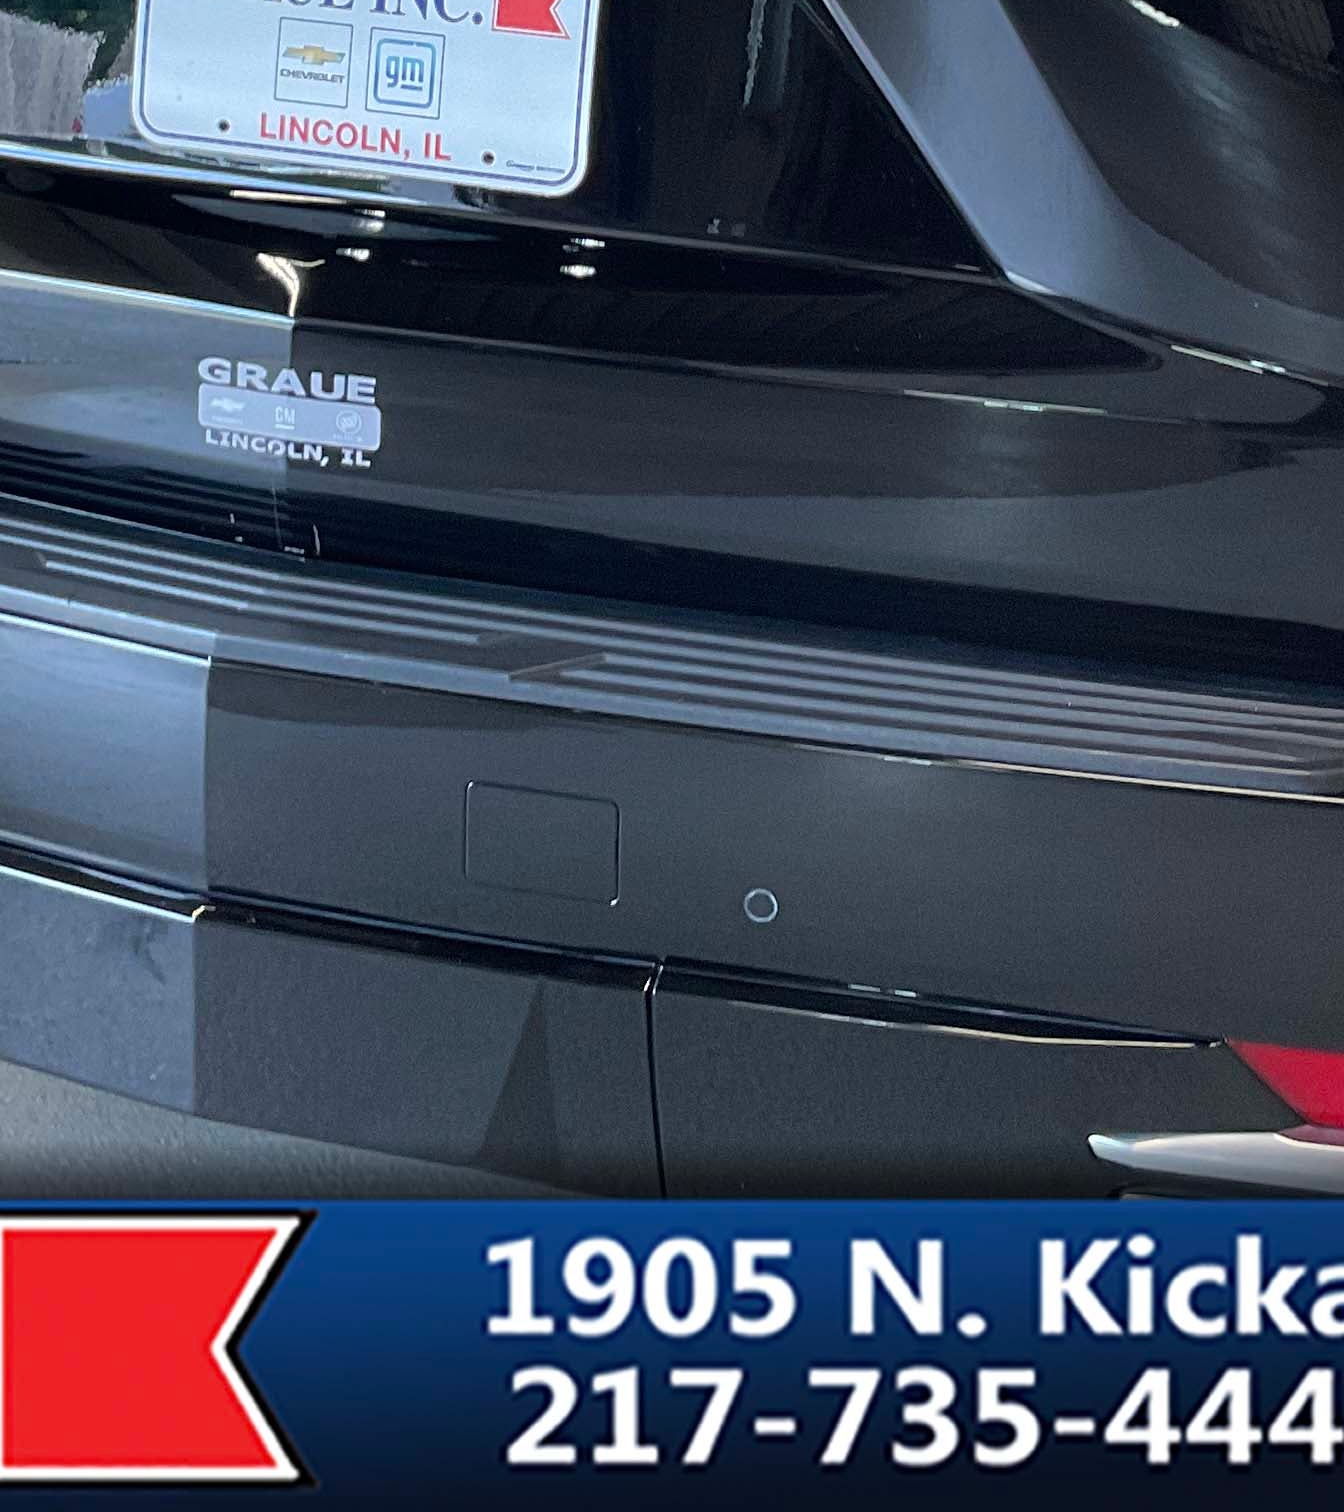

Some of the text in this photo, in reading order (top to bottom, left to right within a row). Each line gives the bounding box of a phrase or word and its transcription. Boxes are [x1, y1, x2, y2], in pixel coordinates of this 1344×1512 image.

[279, 67, 346, 85] CHEVROLET
[259, 112, 453, 162] LINCOLN, IL
[198, 356, 377, 405] GRAUE
[205, 427, 372, 468] LINCOLN, IL
